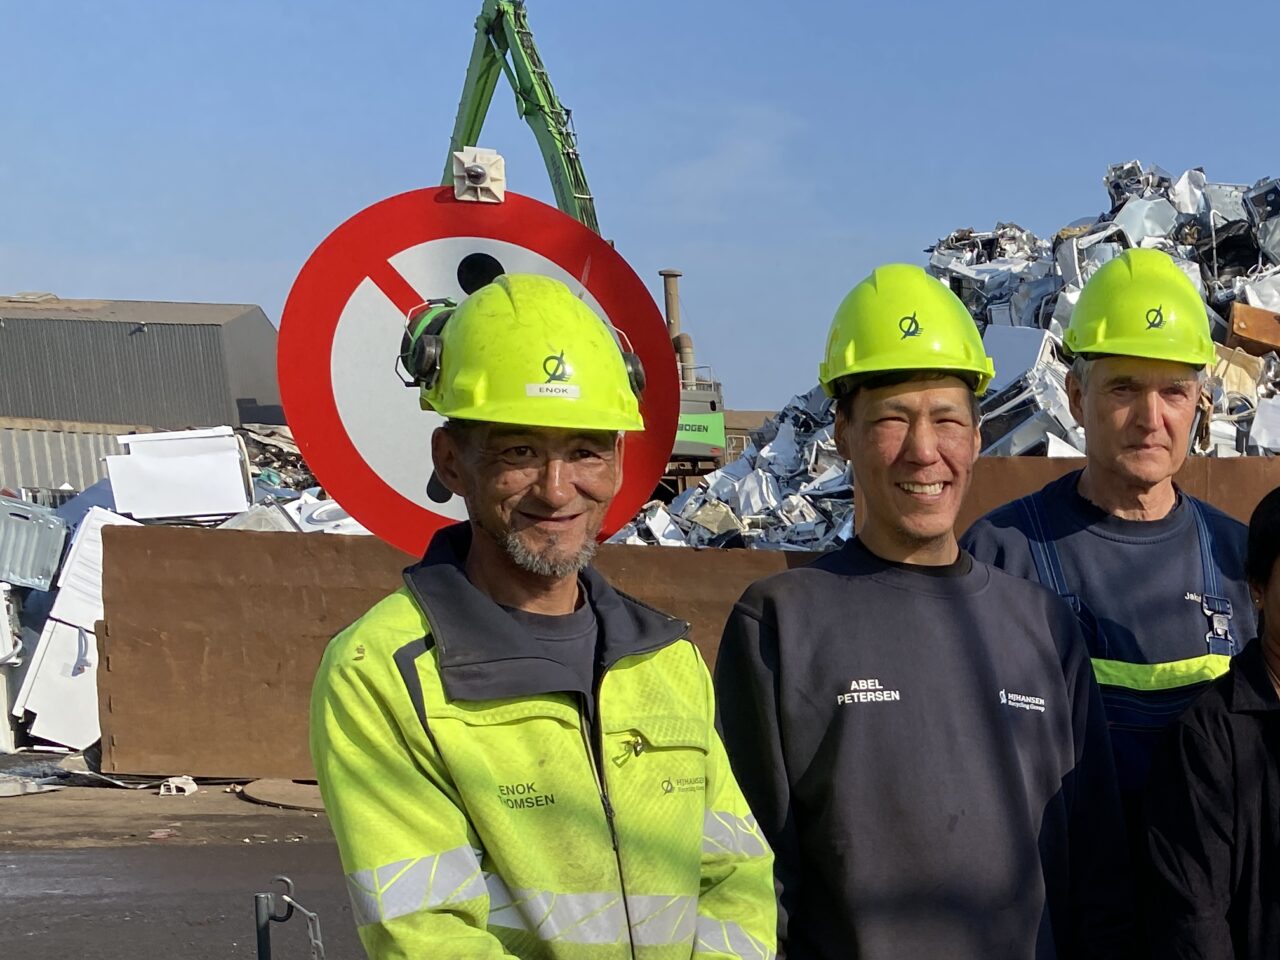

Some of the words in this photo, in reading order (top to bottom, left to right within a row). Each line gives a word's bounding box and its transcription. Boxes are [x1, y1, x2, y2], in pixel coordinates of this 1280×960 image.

[850, 679, 883, 691] ABEL
[837, 690, 900, 705] PETERSEN
[498, 782, 538, 796] ENOK
[497, 793, 556, 809] OMSEN
